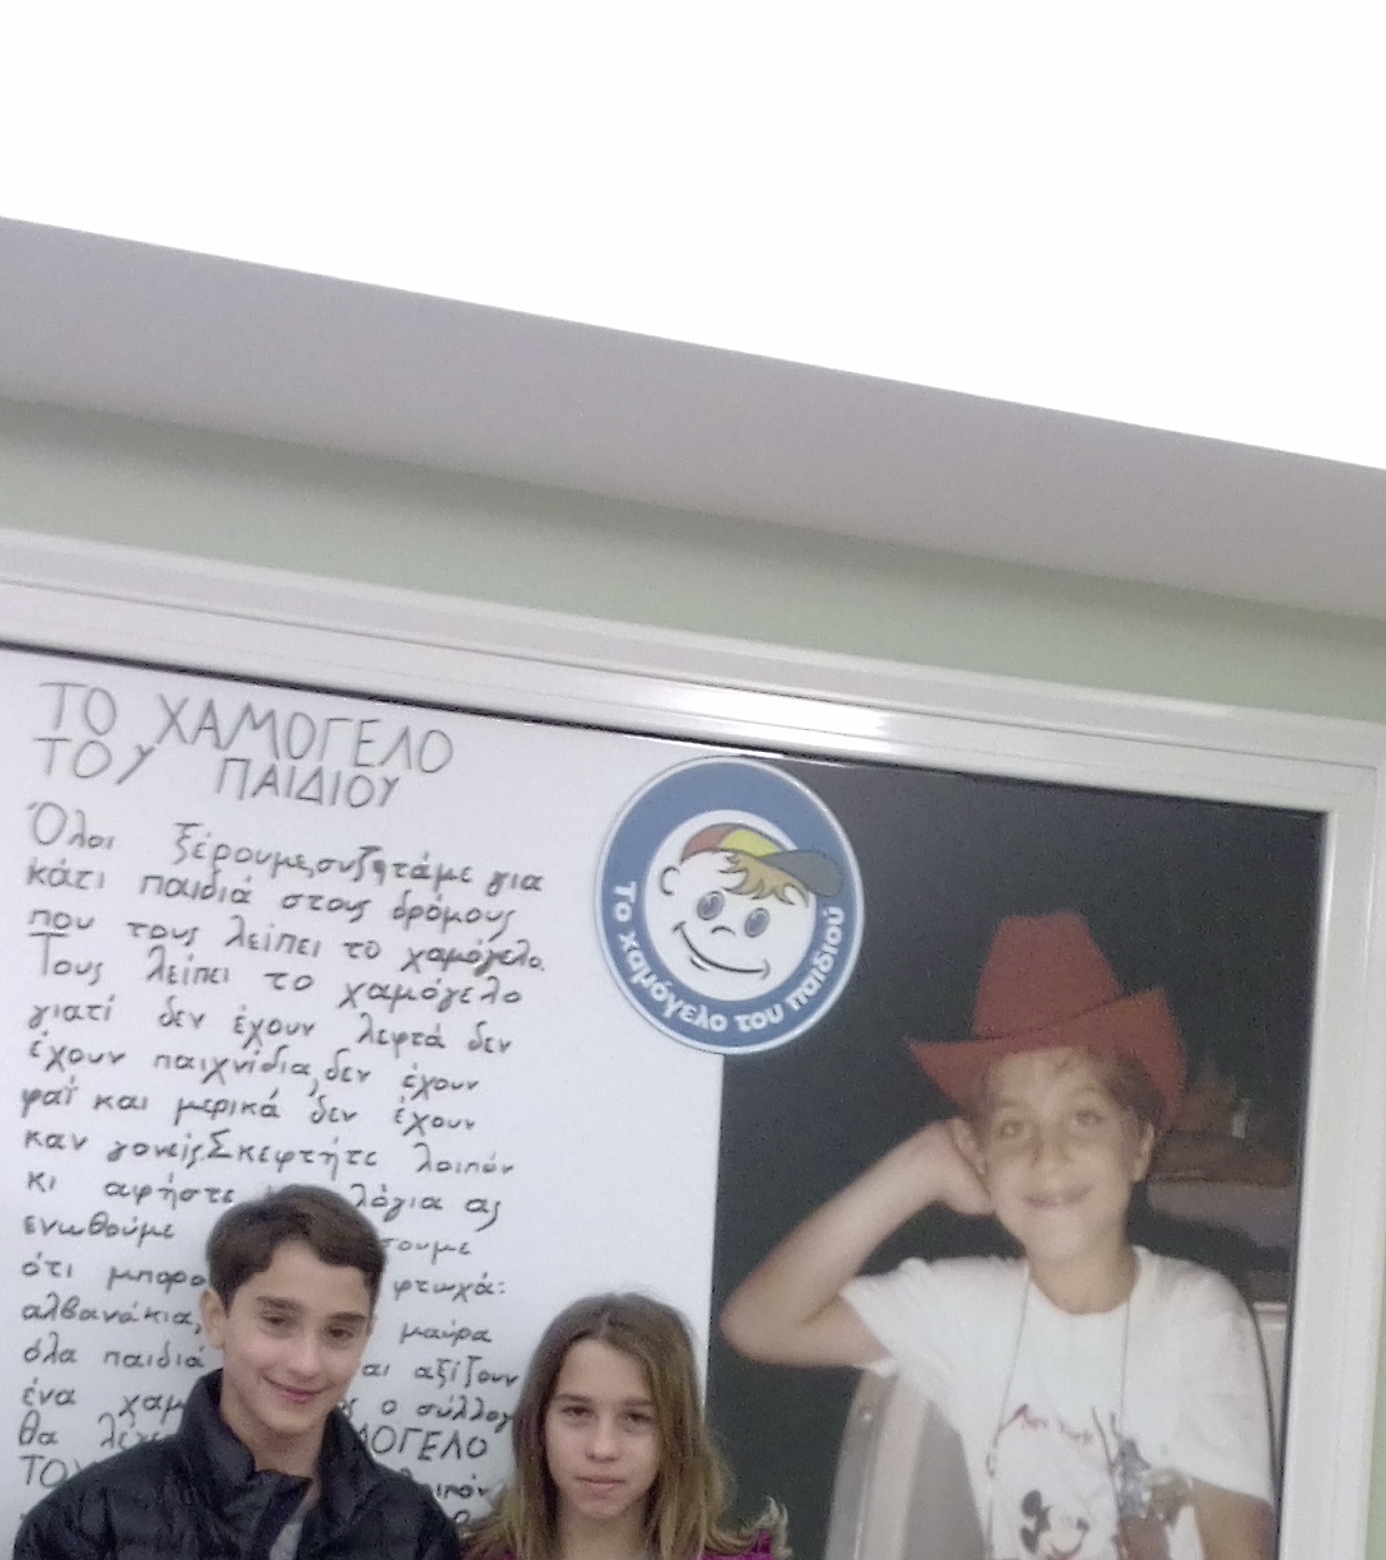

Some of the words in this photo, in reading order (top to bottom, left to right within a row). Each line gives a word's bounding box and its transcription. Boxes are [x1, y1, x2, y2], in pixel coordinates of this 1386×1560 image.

[39, 682, 117, 736] ΤΟ
[155, 694, 454, 773] ΧΑΜΟΓΕΛΟ
[216, 757, 401, 808] ΠΑΙΔΙΟΥ
[26, 856, 105, 890] κάτι
[281, 893, 372, 924] στους
[392, 889, 517, 943] δρόμους
[485, 869, 544, 897] για
[28, 908, 95, 931] που
[126, 921, 200, 948] τους
[225, 913, 322, 958] λείπει
[343, 939, 382, 960] το
[28, 931, 104, 987] Τους
[146, 944, 231, 986] λείπει
[263, 971, 315, 992] το
[337, 975, 522, 1014] χαμόγελο
[28, 994, 116, 1029] γιατί
[159, 994, 207, 1030] δεν
[234, 1003, 316, 1051] έχουν
[357, 1011, 446, 1060] λεφτά
[467, 1020, 513, 1054] δεν
[735, 1003, 785, 1033] του
[29, 1029, 127, 1074] έχουν
[325, 1047, 372, 1084] δεν
[402, 1062, 480, 1102] έχουν
[93, 1093, 149, 1111] και
[174, 1087, 281, 1127] μερικά
[310, 1094, 359, 1125] δεν
[394, 1095, 476, 1138] έχουν
[25, 1129, 89, 1151] καν
[413, 1141, 515, 1175] λοιπόν
[465, 1197, 502, 1233] ας
[21, 1250, 74, 1279] ότι
[106, 1265, 207, 1295] μπορο
[24, 1330, 79, 1365] όλα
[103, 1338, 207, 1370] παιδιά
[362, 1363, 391, 1378] αι
[18, 1408, 59, 1448] θα
[21, 1376, 77, 1408] ένα
[117, 1393, 188, 1429] χαμ
[416, 1393, 514, 1435] σύλλογ
